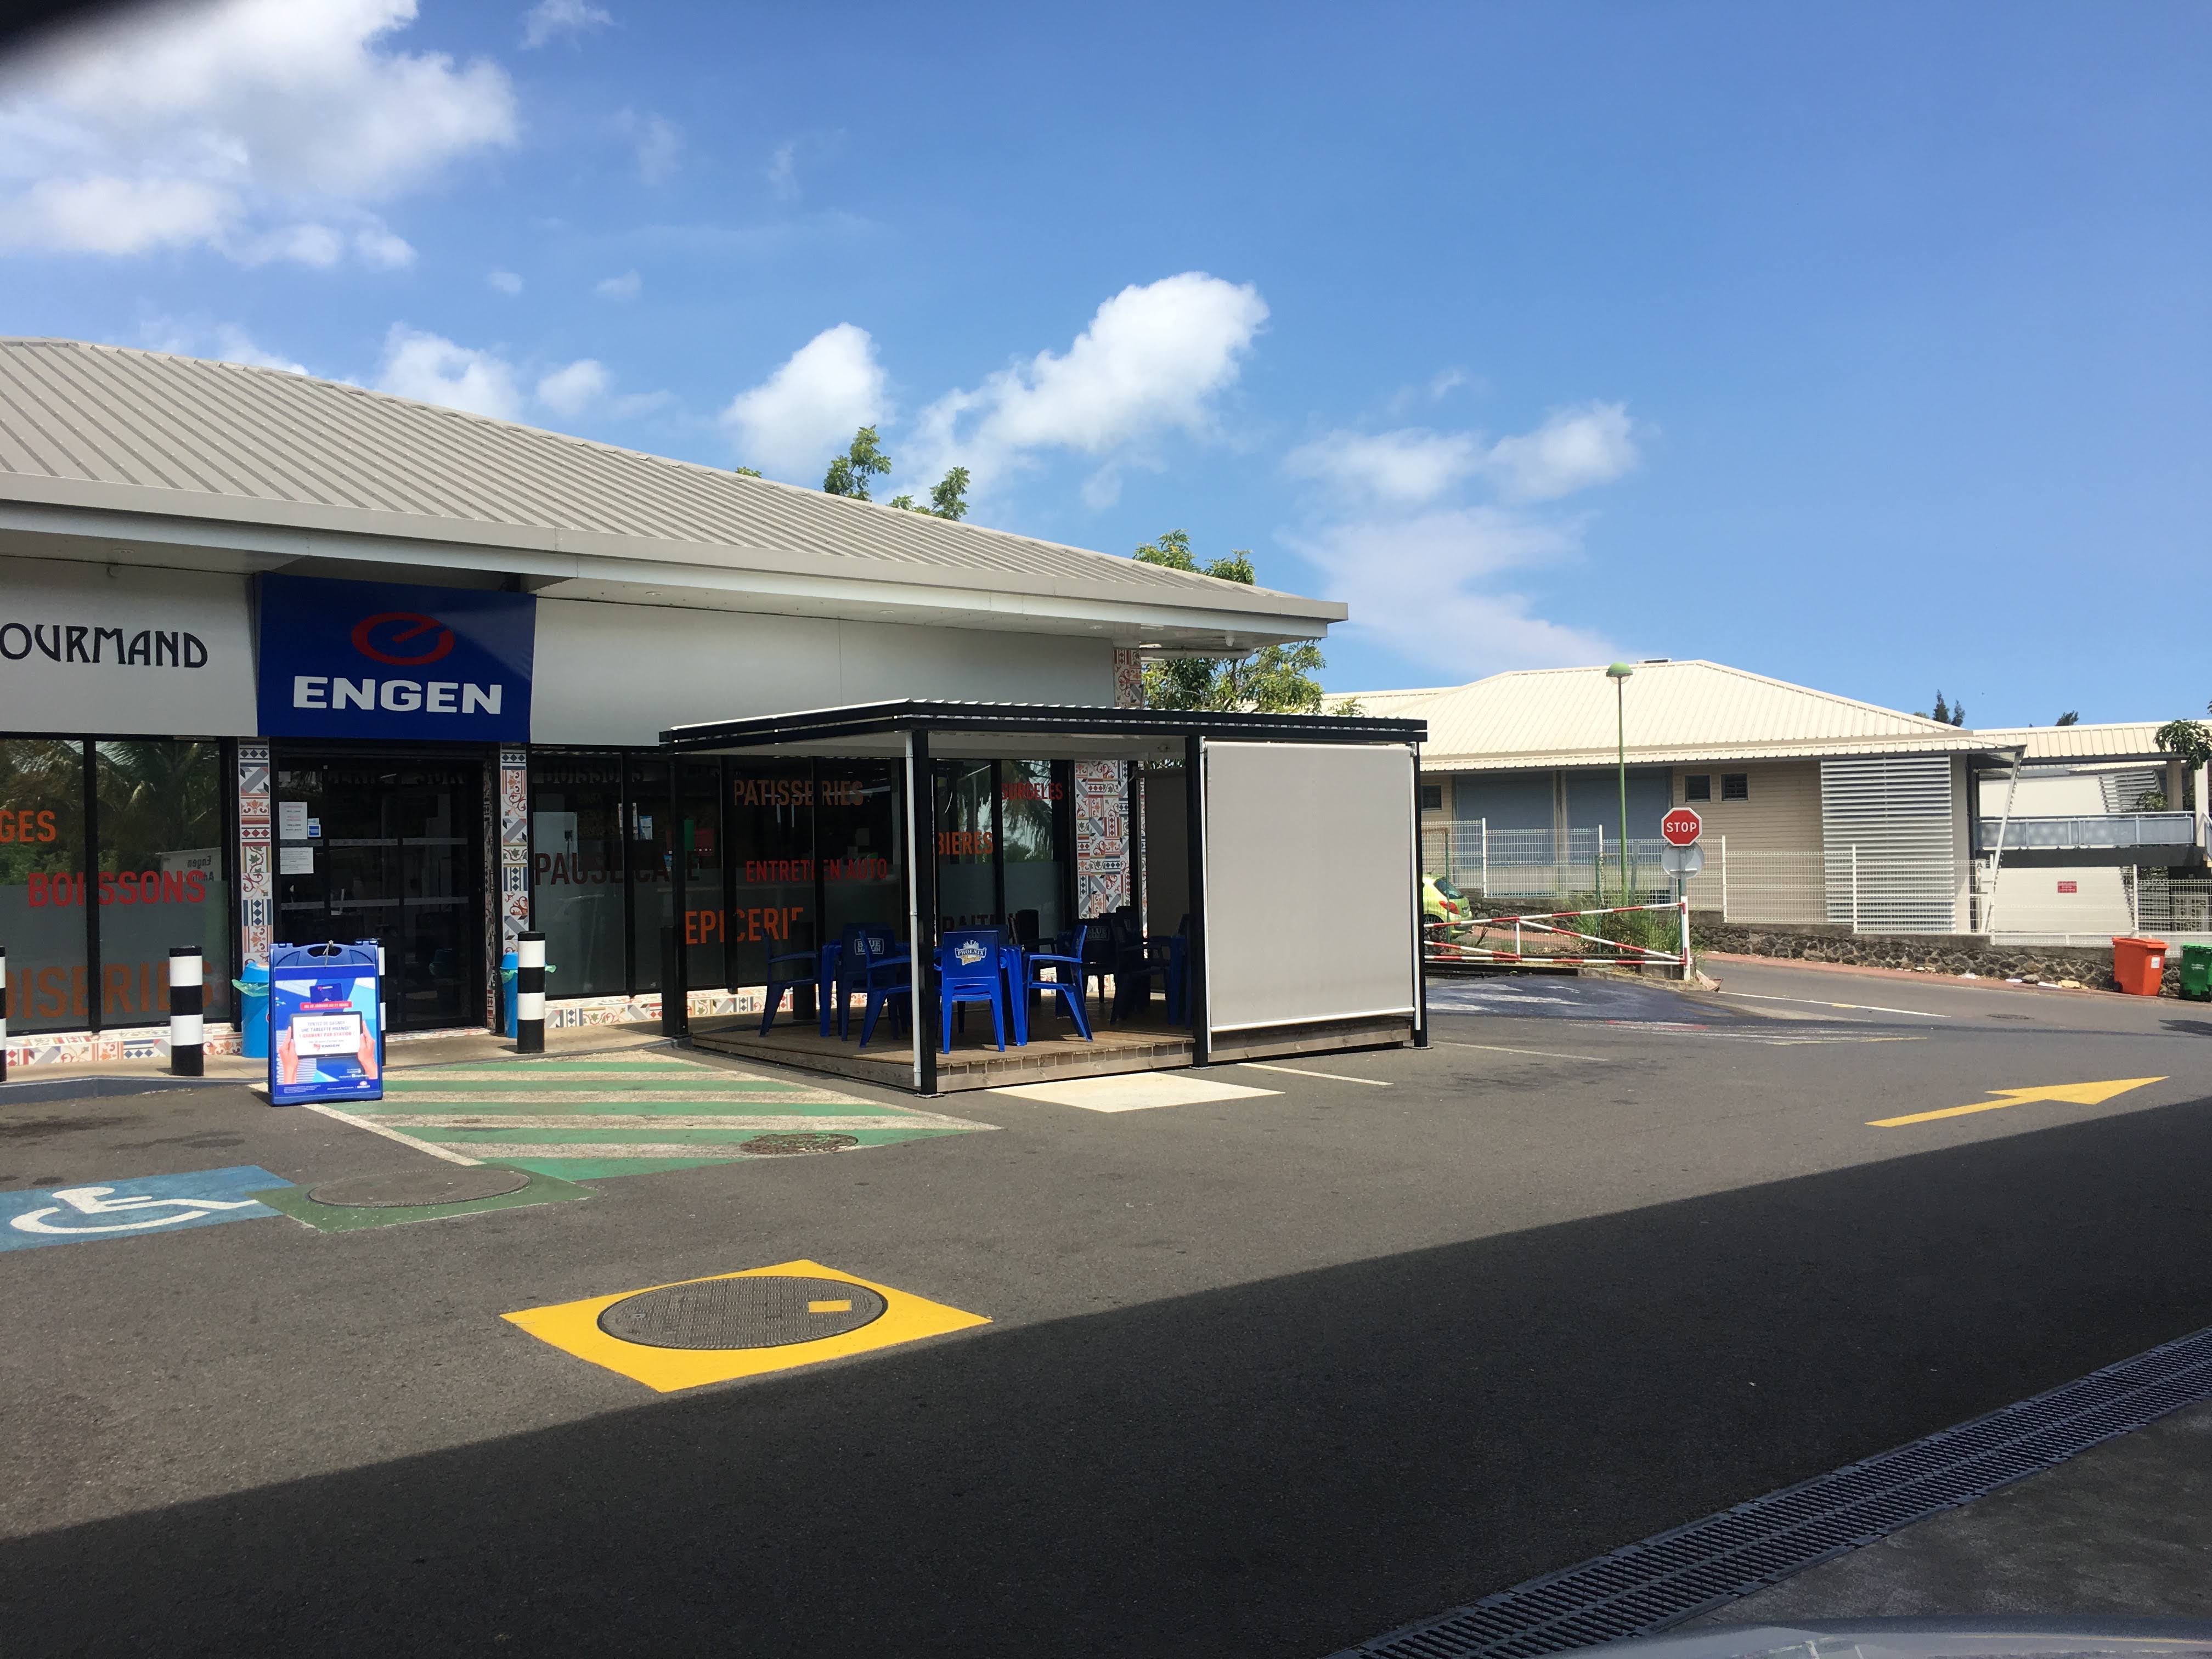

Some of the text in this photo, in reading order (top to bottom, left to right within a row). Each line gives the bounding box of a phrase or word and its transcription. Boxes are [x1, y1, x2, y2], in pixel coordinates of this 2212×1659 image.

[293, 675, 503, 714] ENGEN
[734, 779, 864, 806] PATISSERIES
[1001, 782, 1063, 800] SURGELES
[0, 810, 56, 843] GES
[1666, 822, 1697, 832] STOP
[534, 852, 624, 885] PAUSE
[845, 858, 887, 881] AUTO
[28, 870, 206, 907] BOISSONS
